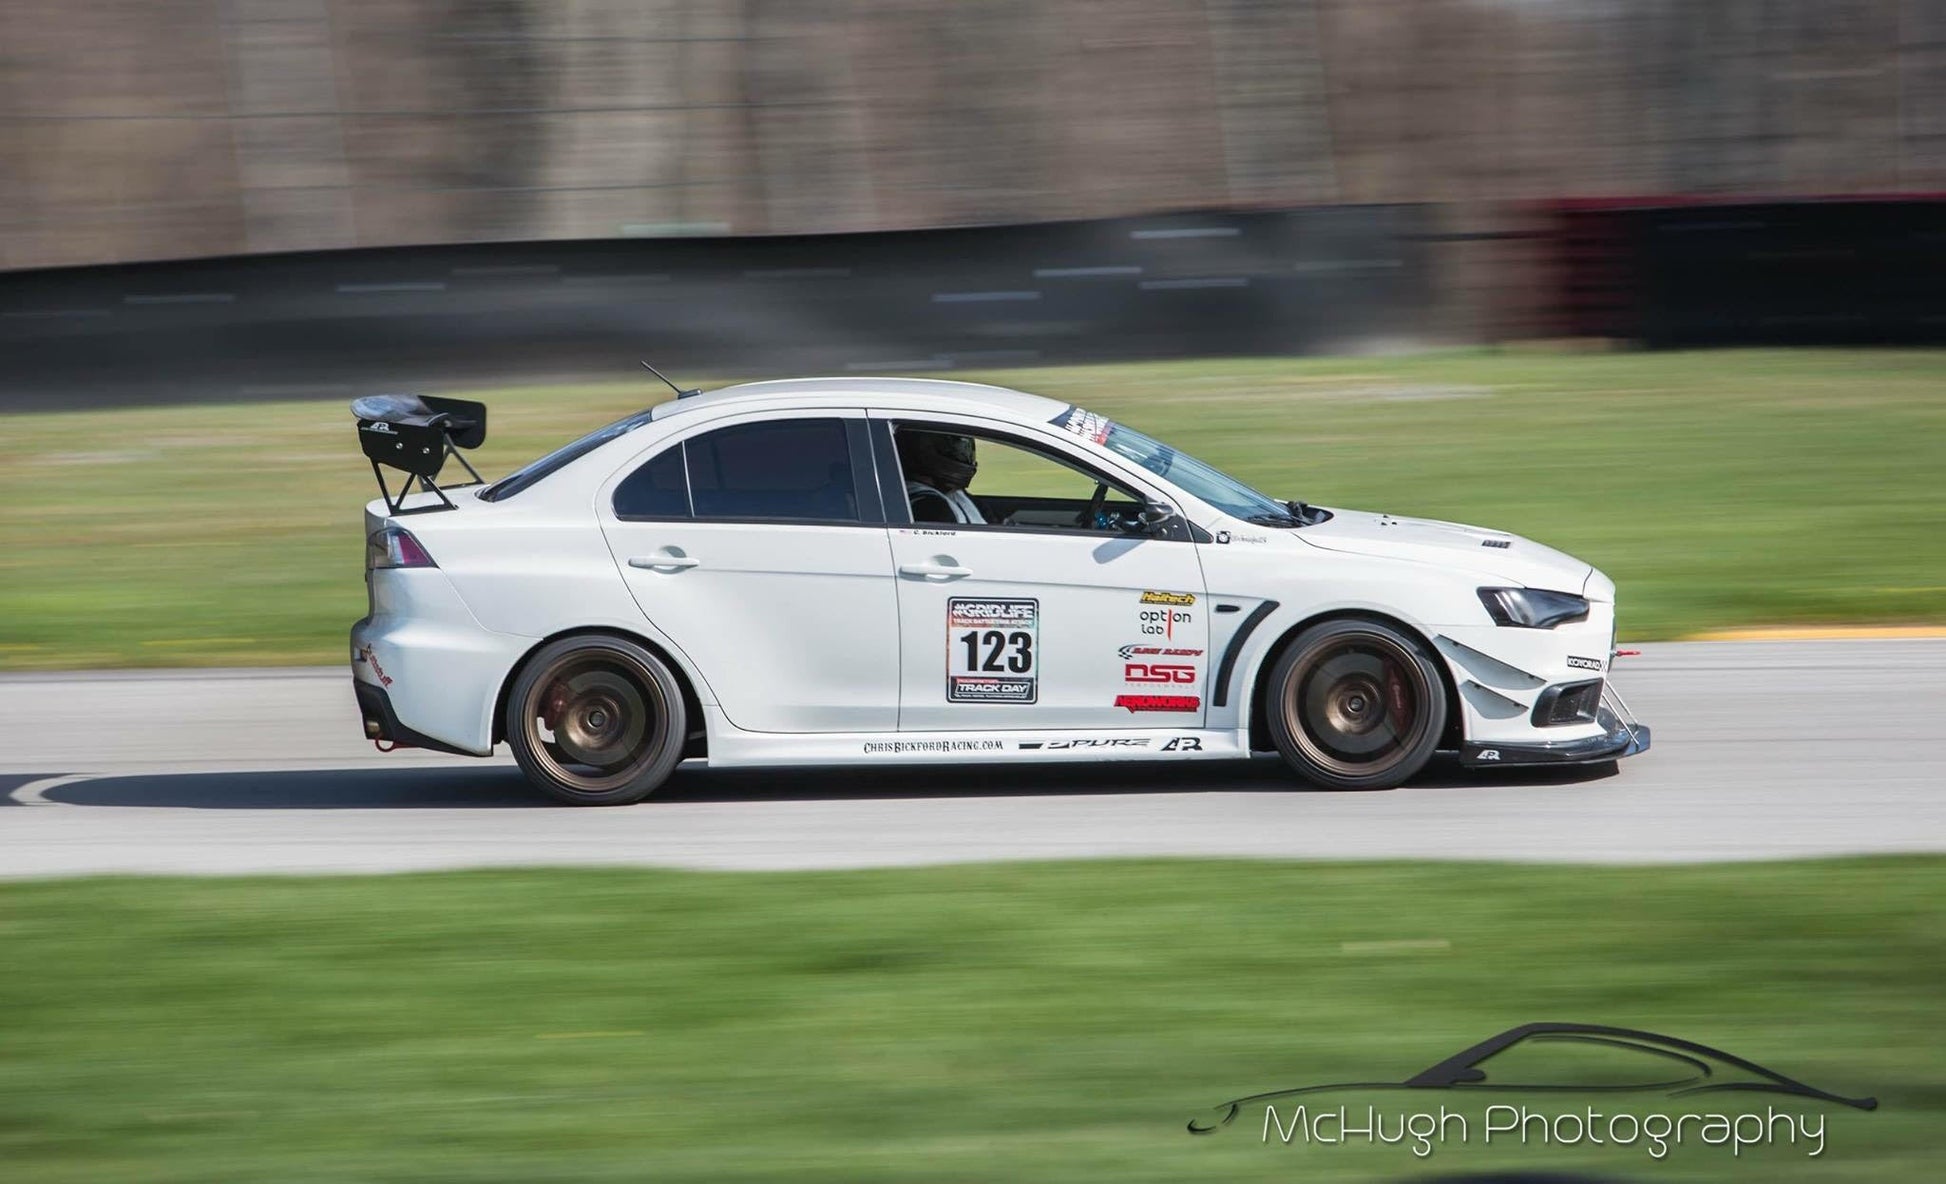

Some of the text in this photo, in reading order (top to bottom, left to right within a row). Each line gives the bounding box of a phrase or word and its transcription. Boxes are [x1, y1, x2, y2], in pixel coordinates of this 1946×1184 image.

[953, 603, 1034, 618] #GRIDLIFE
[1141, 623, 1164, 635] lab
[961, 630, 1032, 673] 123
[959, 683, 1027, 693] TRACK DAY
